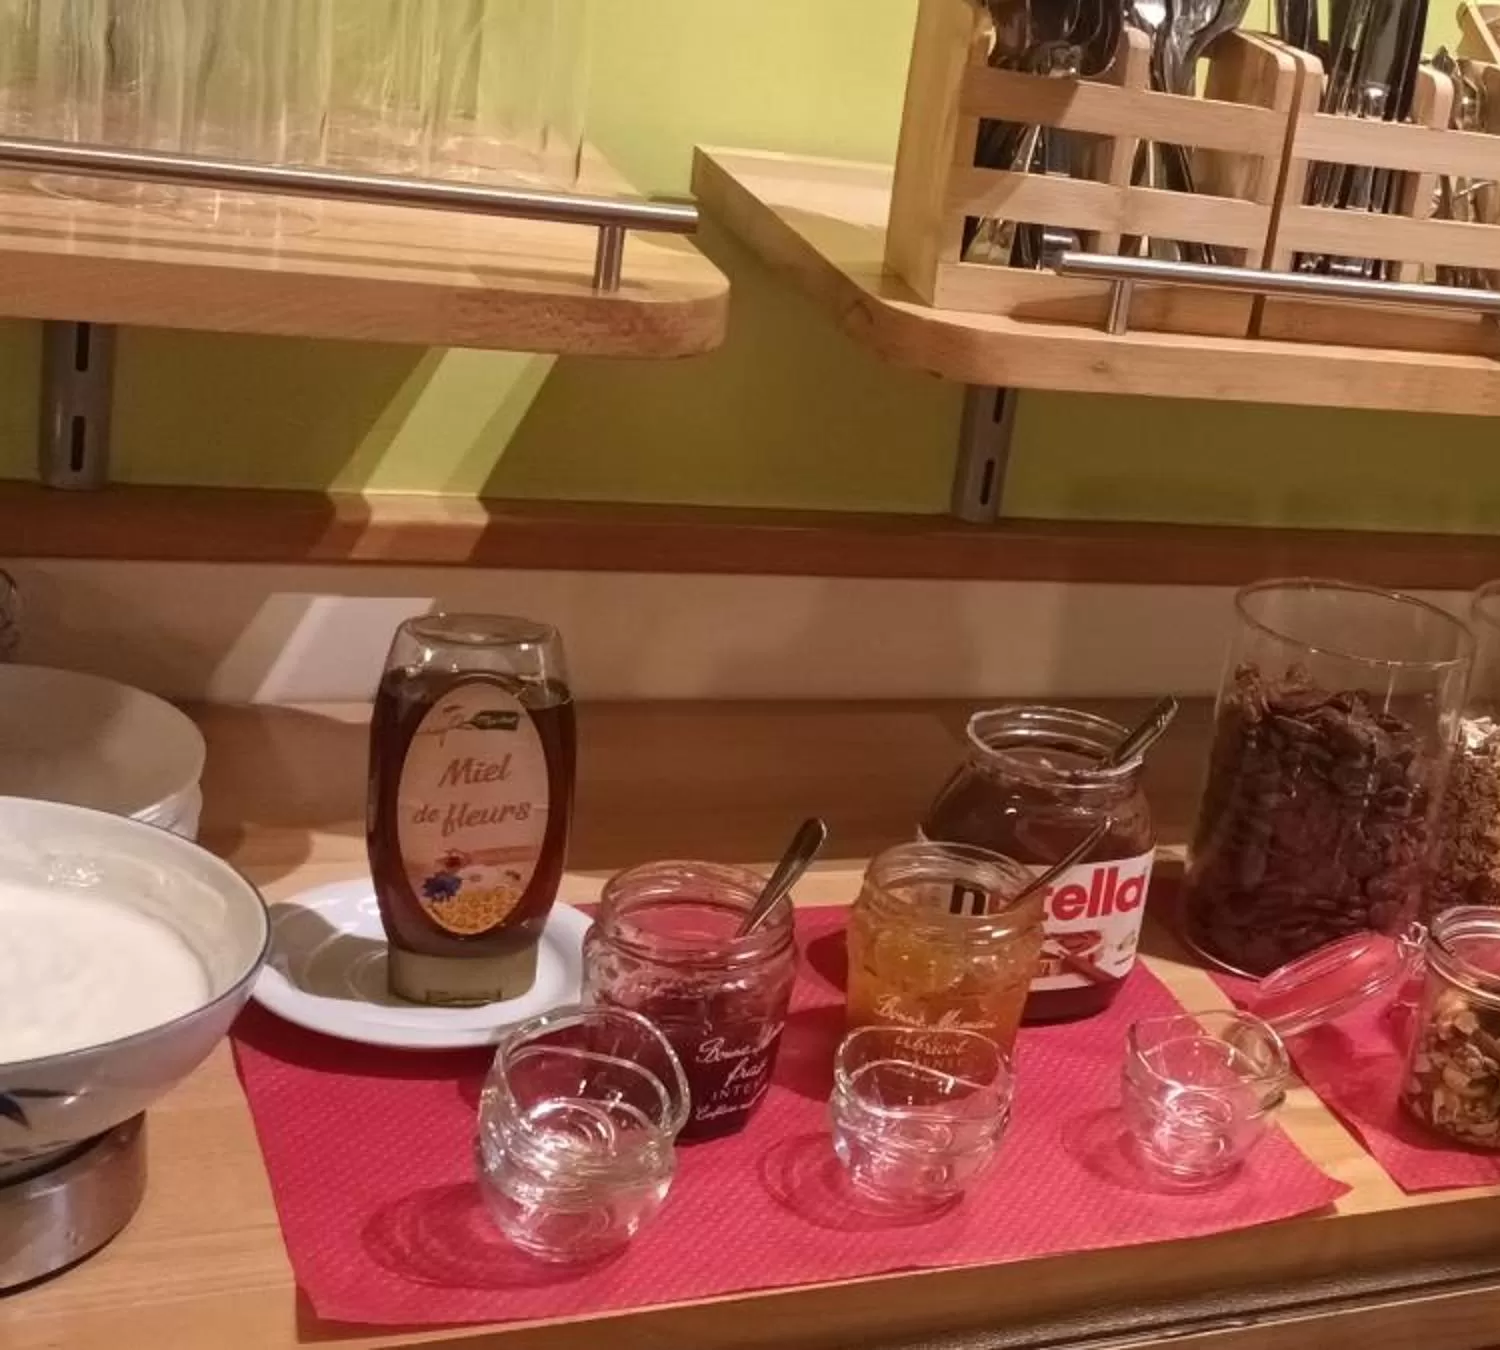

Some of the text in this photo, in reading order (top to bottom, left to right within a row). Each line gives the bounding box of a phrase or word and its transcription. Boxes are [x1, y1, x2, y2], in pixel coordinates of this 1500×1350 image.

[438, 753, 512, 788] Miel
[412, 801, 531, 837] de fleurs
